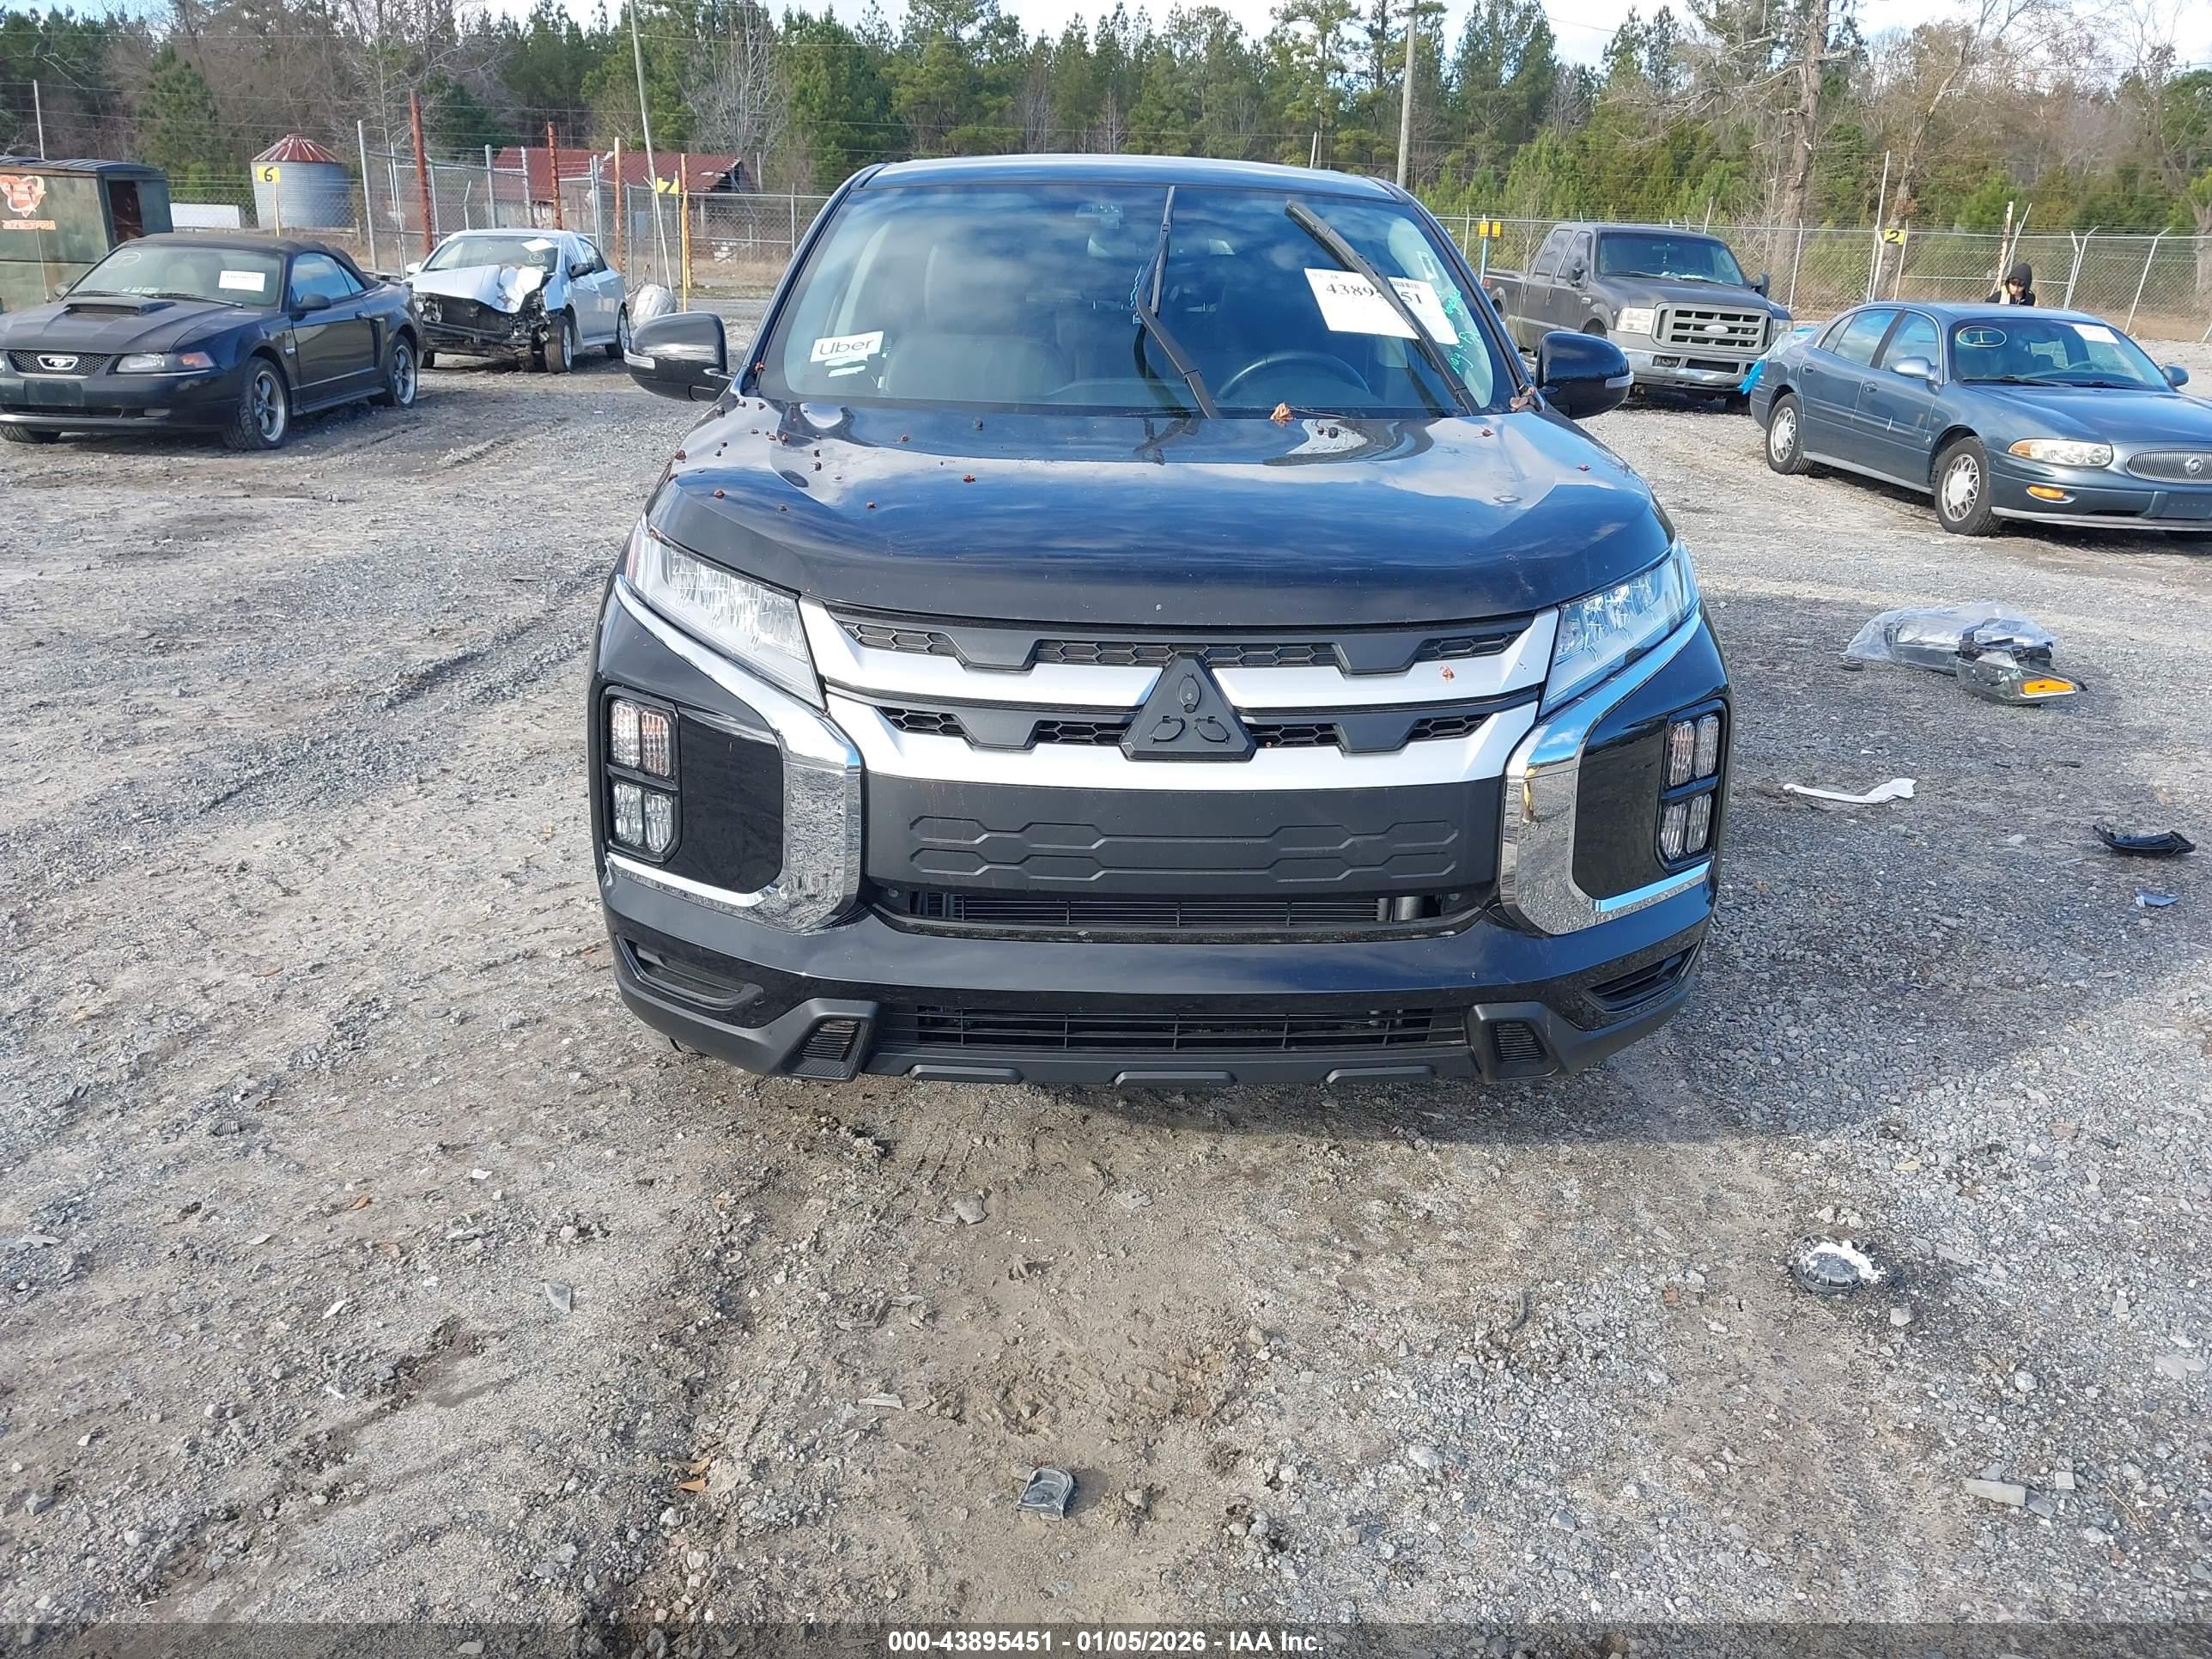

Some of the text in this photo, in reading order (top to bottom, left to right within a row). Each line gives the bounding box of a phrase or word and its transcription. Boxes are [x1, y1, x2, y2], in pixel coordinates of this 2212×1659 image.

[264, 167, 274, 182] 6
[1885, 230, 1899, 244] 2
[1326, 283, 1423, 304] 438951
[819, 339, 875, 356] Uber
